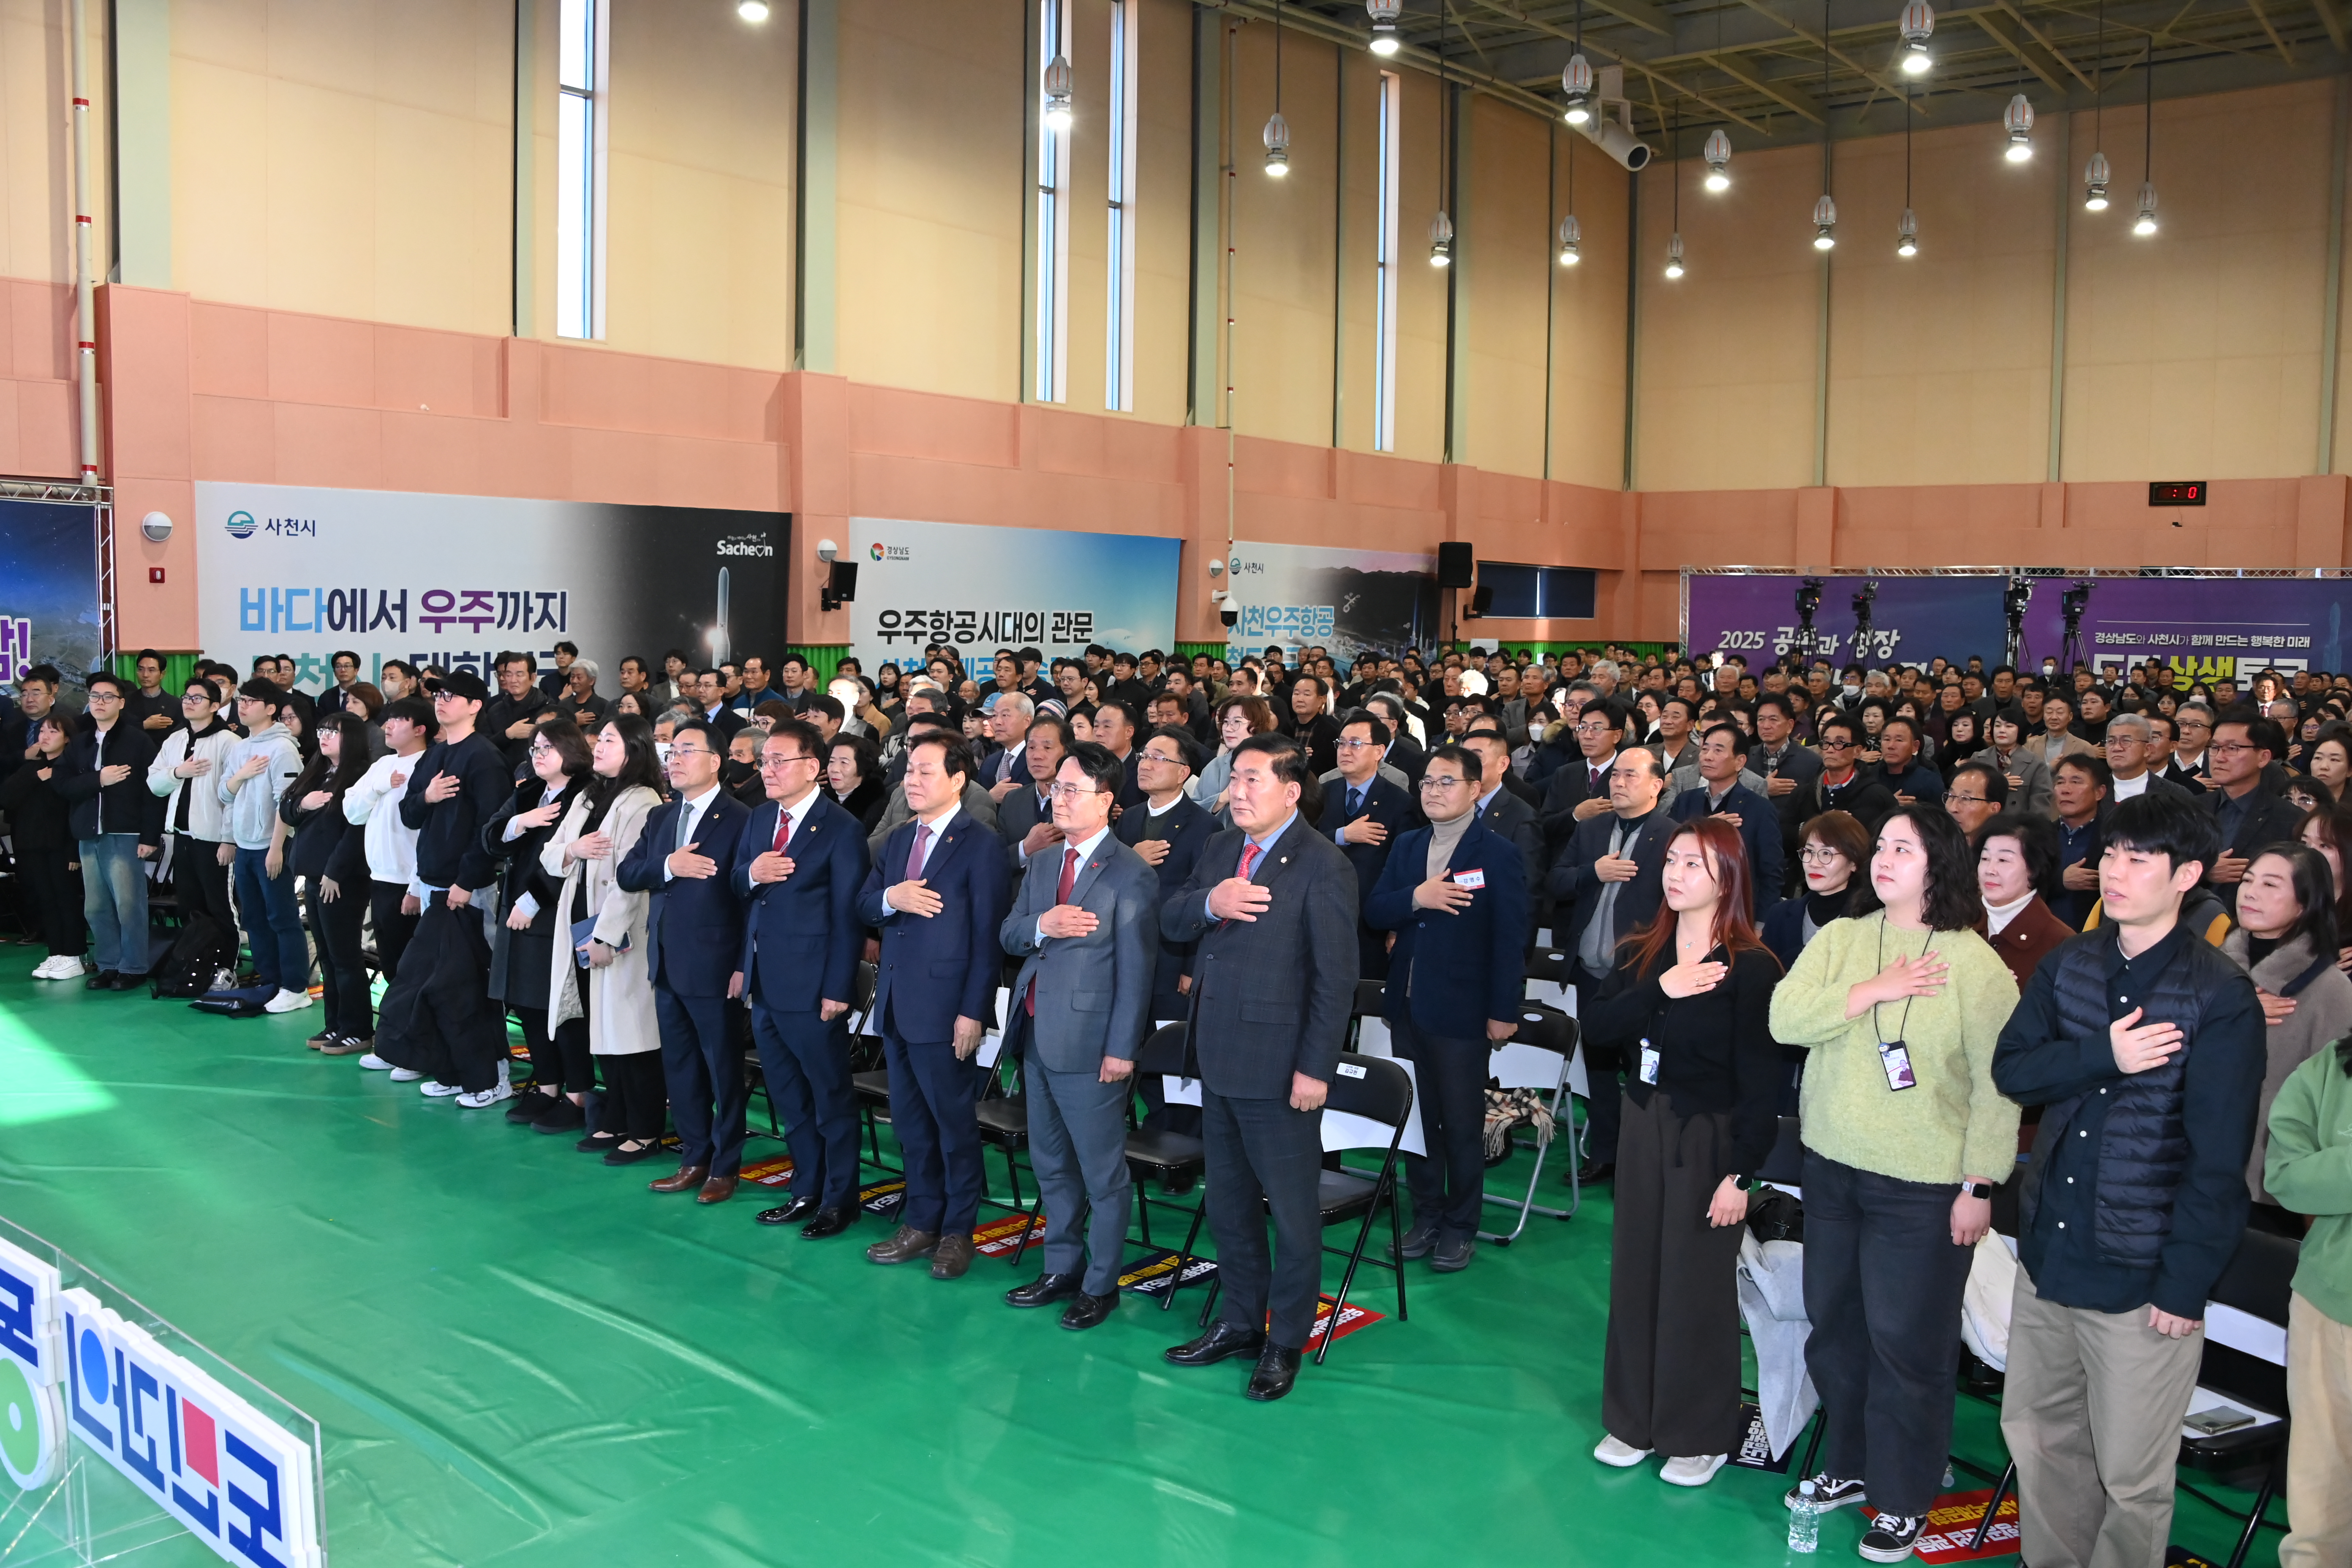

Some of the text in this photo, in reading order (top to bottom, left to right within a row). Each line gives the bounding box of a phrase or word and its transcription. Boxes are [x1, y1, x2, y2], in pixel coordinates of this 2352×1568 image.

[265, 518, 316, 537] 사천시
[887, 546, 909, 555] 경상남도
[1244, 562, 1264, 574] 사천시
[240, 587, 567, 634] 바다에서 우주까지
[877, 610, 1093, 645] 우주항공시대의 관문
[1227, 605, 1335, 638] 사천우주항공
[1718, 631, 1766, 650] 2025
[2095, 632, 2311, 648] 경상남도와 사천시가 함께 만드는 행복한 미래
[1914, 1534, 1955, 1553] 관문
